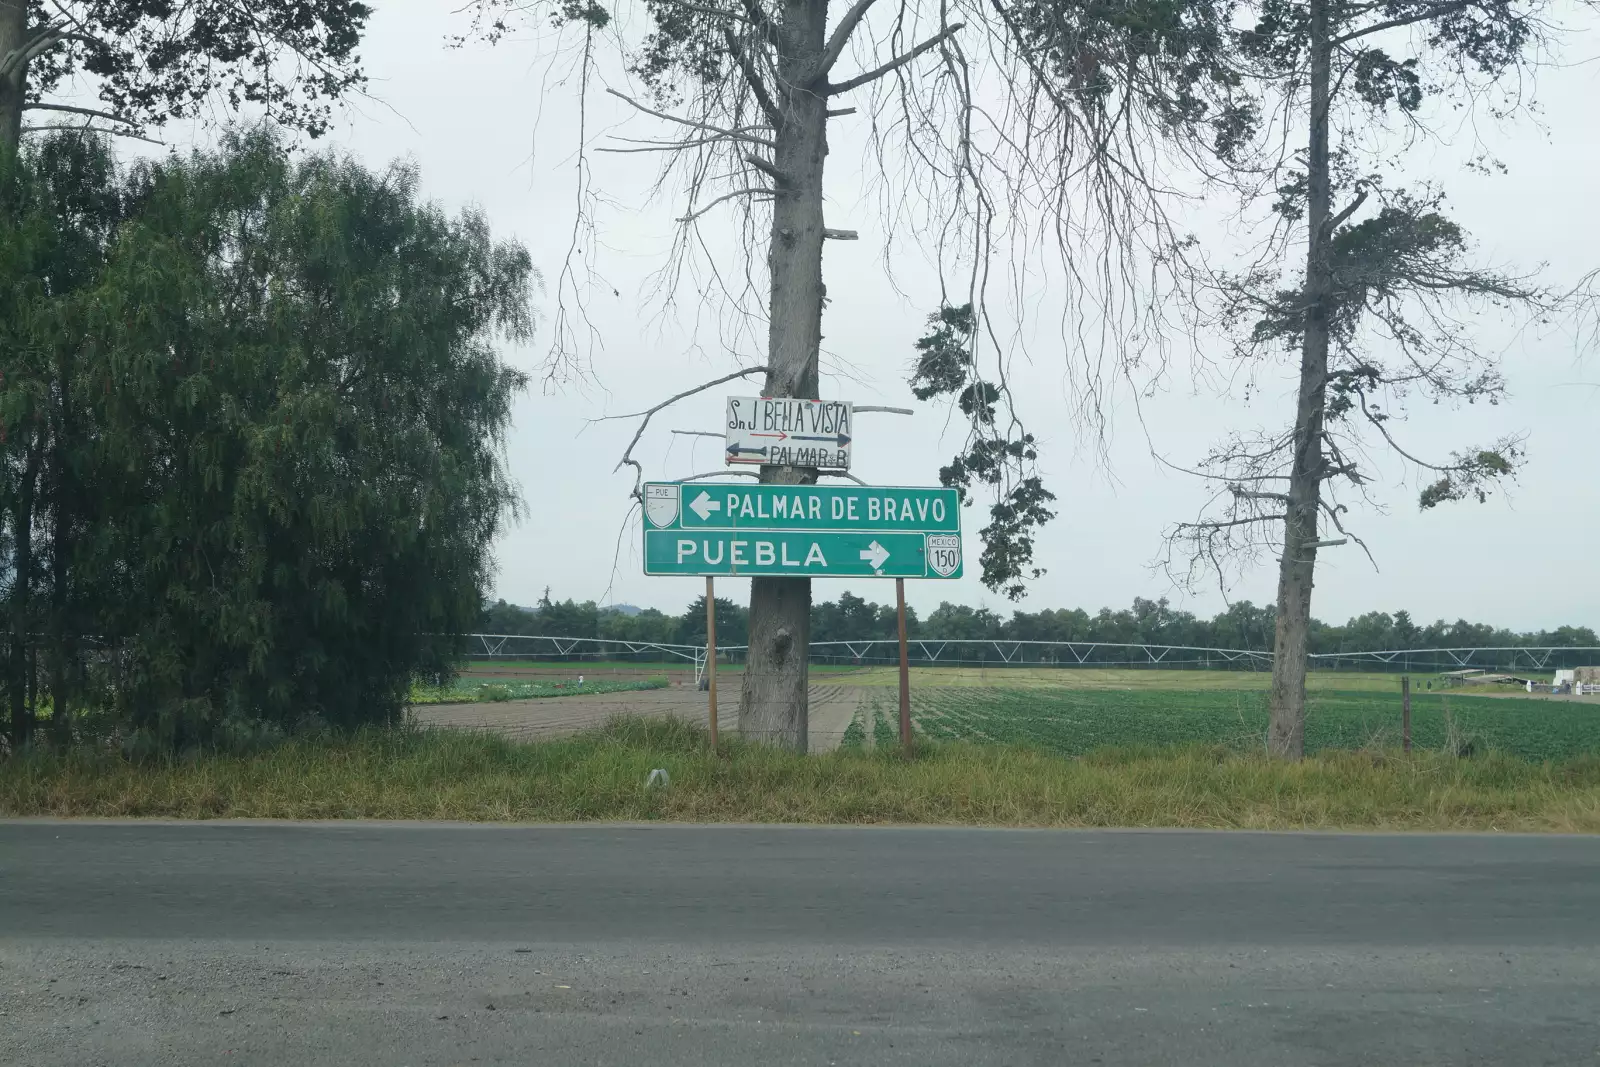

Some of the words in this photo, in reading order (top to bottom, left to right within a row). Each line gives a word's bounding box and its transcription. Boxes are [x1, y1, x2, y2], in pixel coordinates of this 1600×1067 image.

[764, 401, 804, 432] BELLA
[810, 401, 849, 434] VISTA
[770, 446, 828, 467] PALMAR
[656, 488, 668, 496] PUE
[727, 494, 822, 520] PALMAR
[832, 496, 860, 520] DE
[868, 497, 946, 522] BRAVO
[677, 540, 828, 567] PUEBLA
[934, 550, 956, 568] 150
